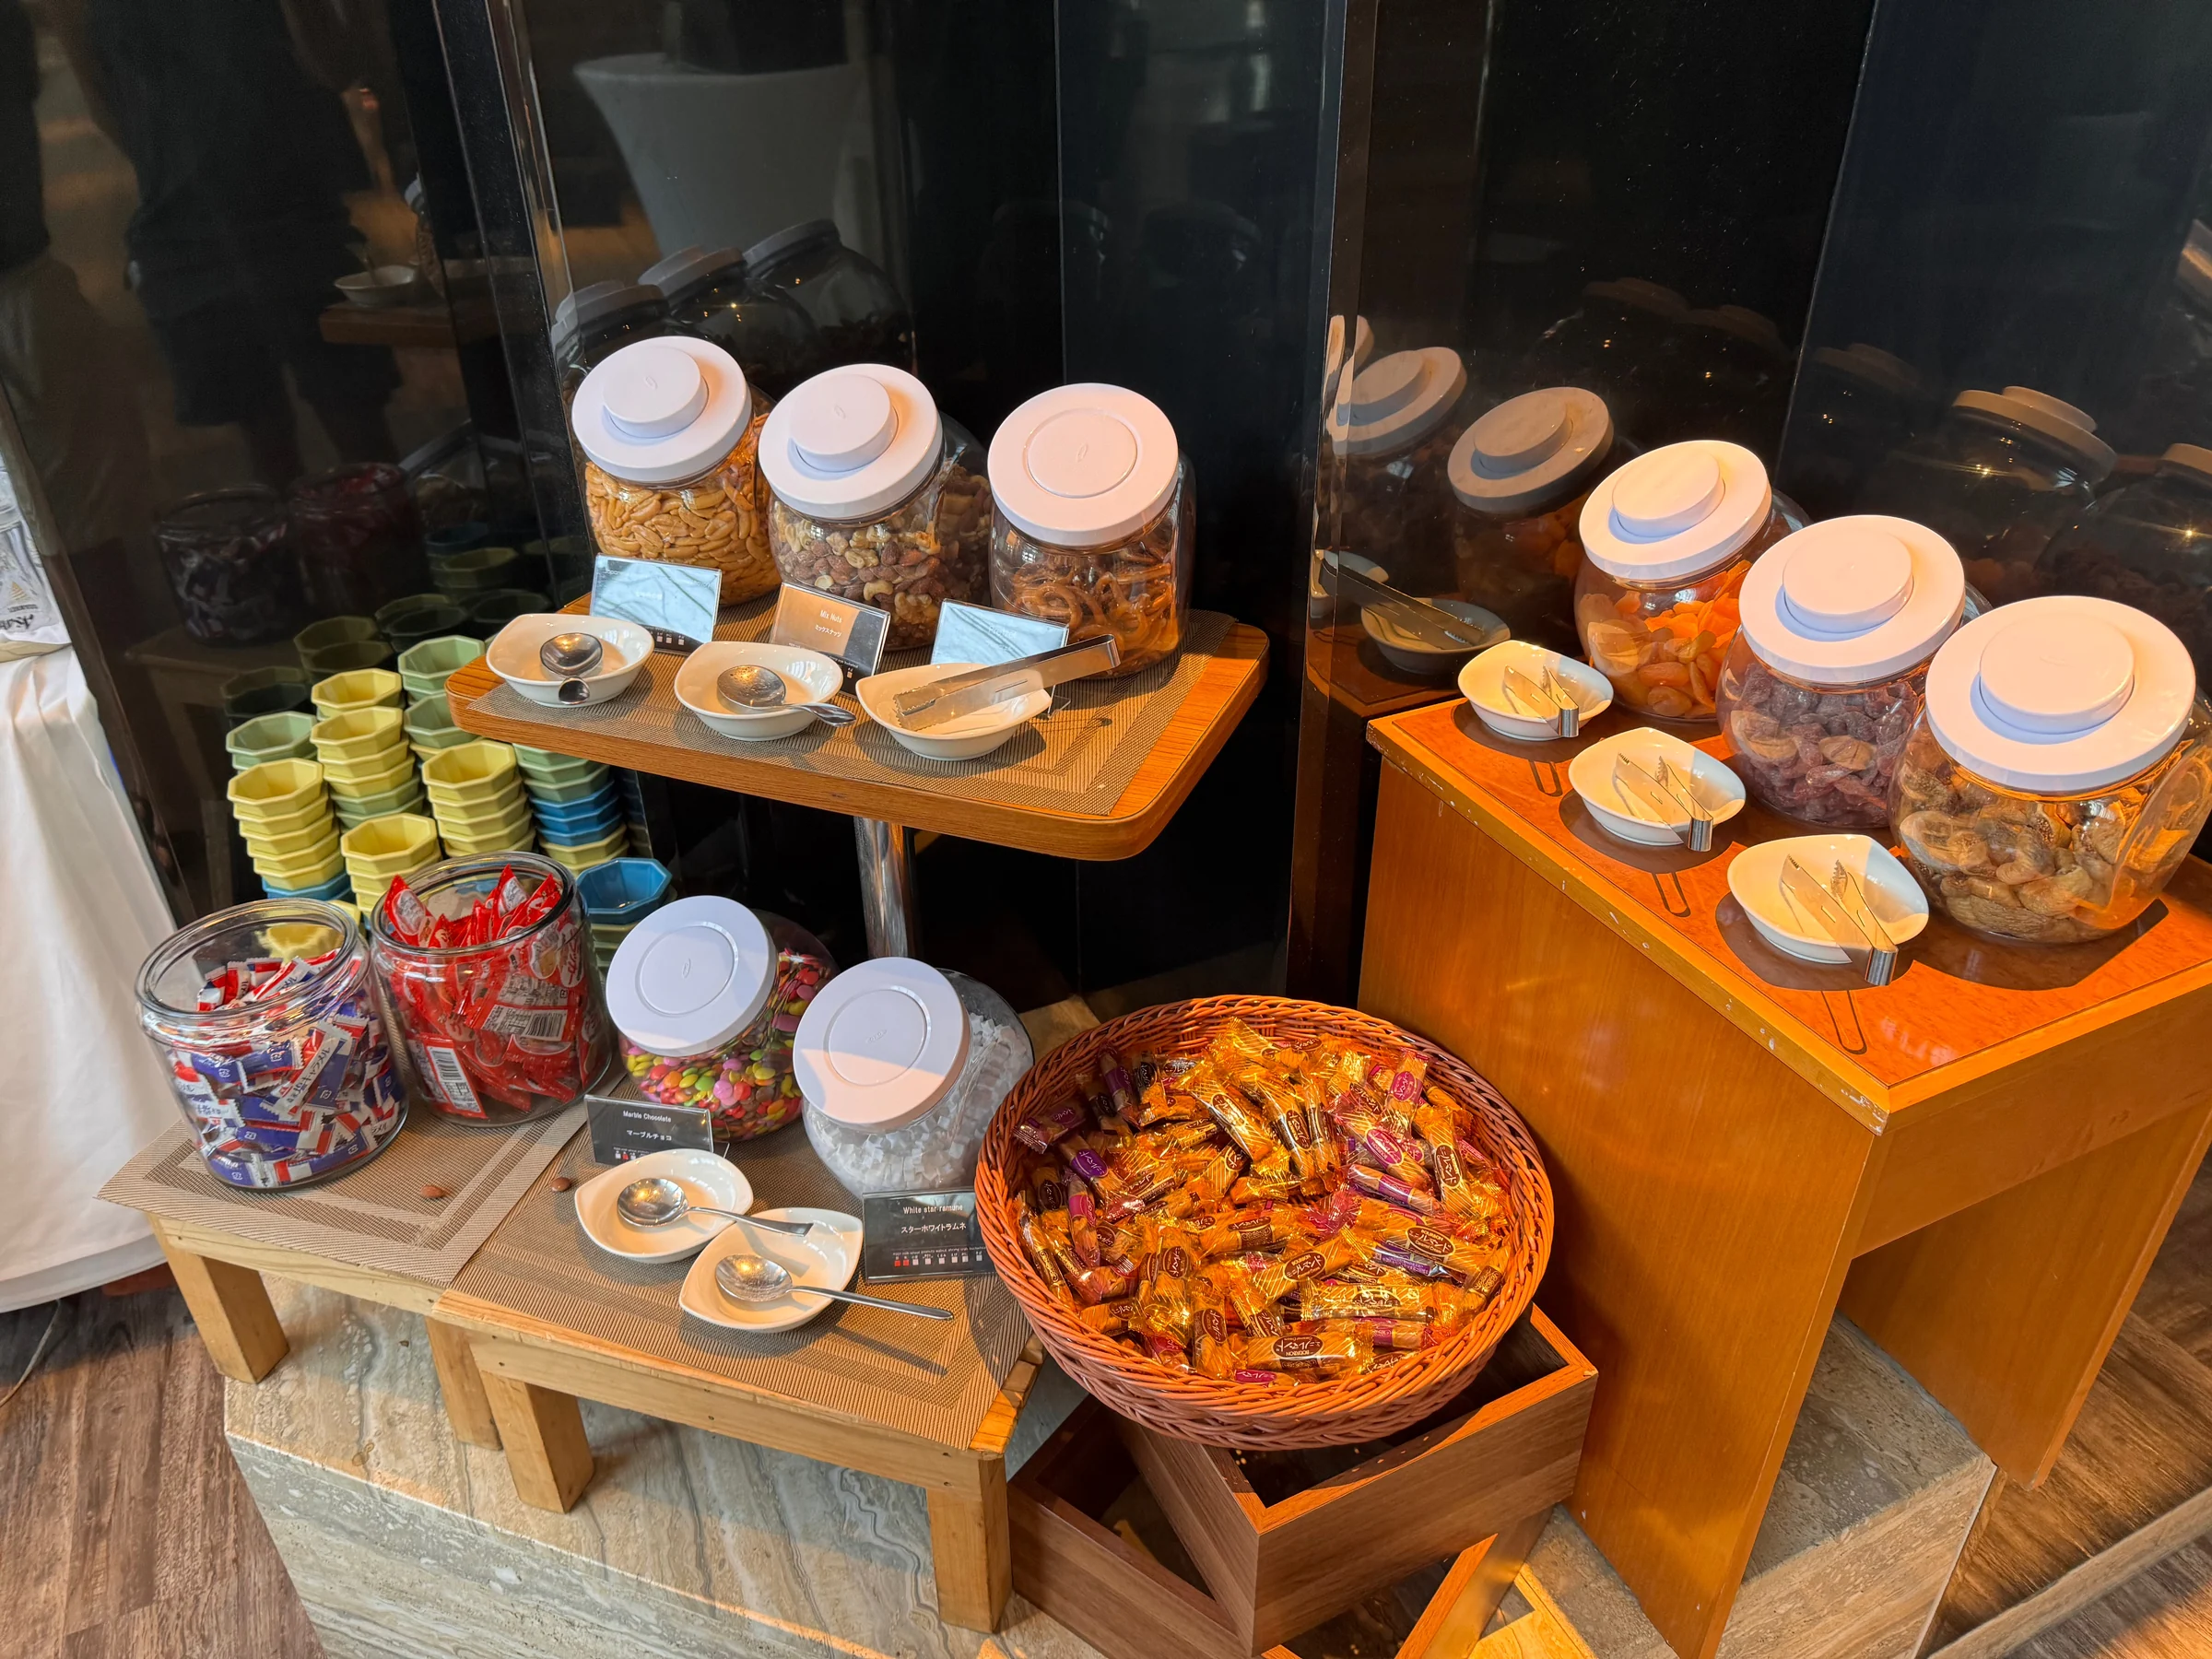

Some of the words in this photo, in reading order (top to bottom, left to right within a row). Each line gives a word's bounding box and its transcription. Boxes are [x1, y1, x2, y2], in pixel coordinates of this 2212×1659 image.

[820, 609, 830, 619] Mix
[830, 612, 842, 623] Nuts
[815, 624, 842, 638] ミックスナッツ
[623, 1110, 642, 1120] Marble
[643, 1112, 672, 1123] Chocolate
[627, 1130, 672, 1141] マーブルチョコ
[903, 1206, 922, 1215] White
[924, 1206, 936, 1214] star
[939, 1204, 963, 1213] ramune
[900, 1222, 967, 1234] スターホワイトラムネ
[1409, 1230, 1451, 1253] ミニルマンド
[1277, 1339, 1320, 1351] ミニルマンド
